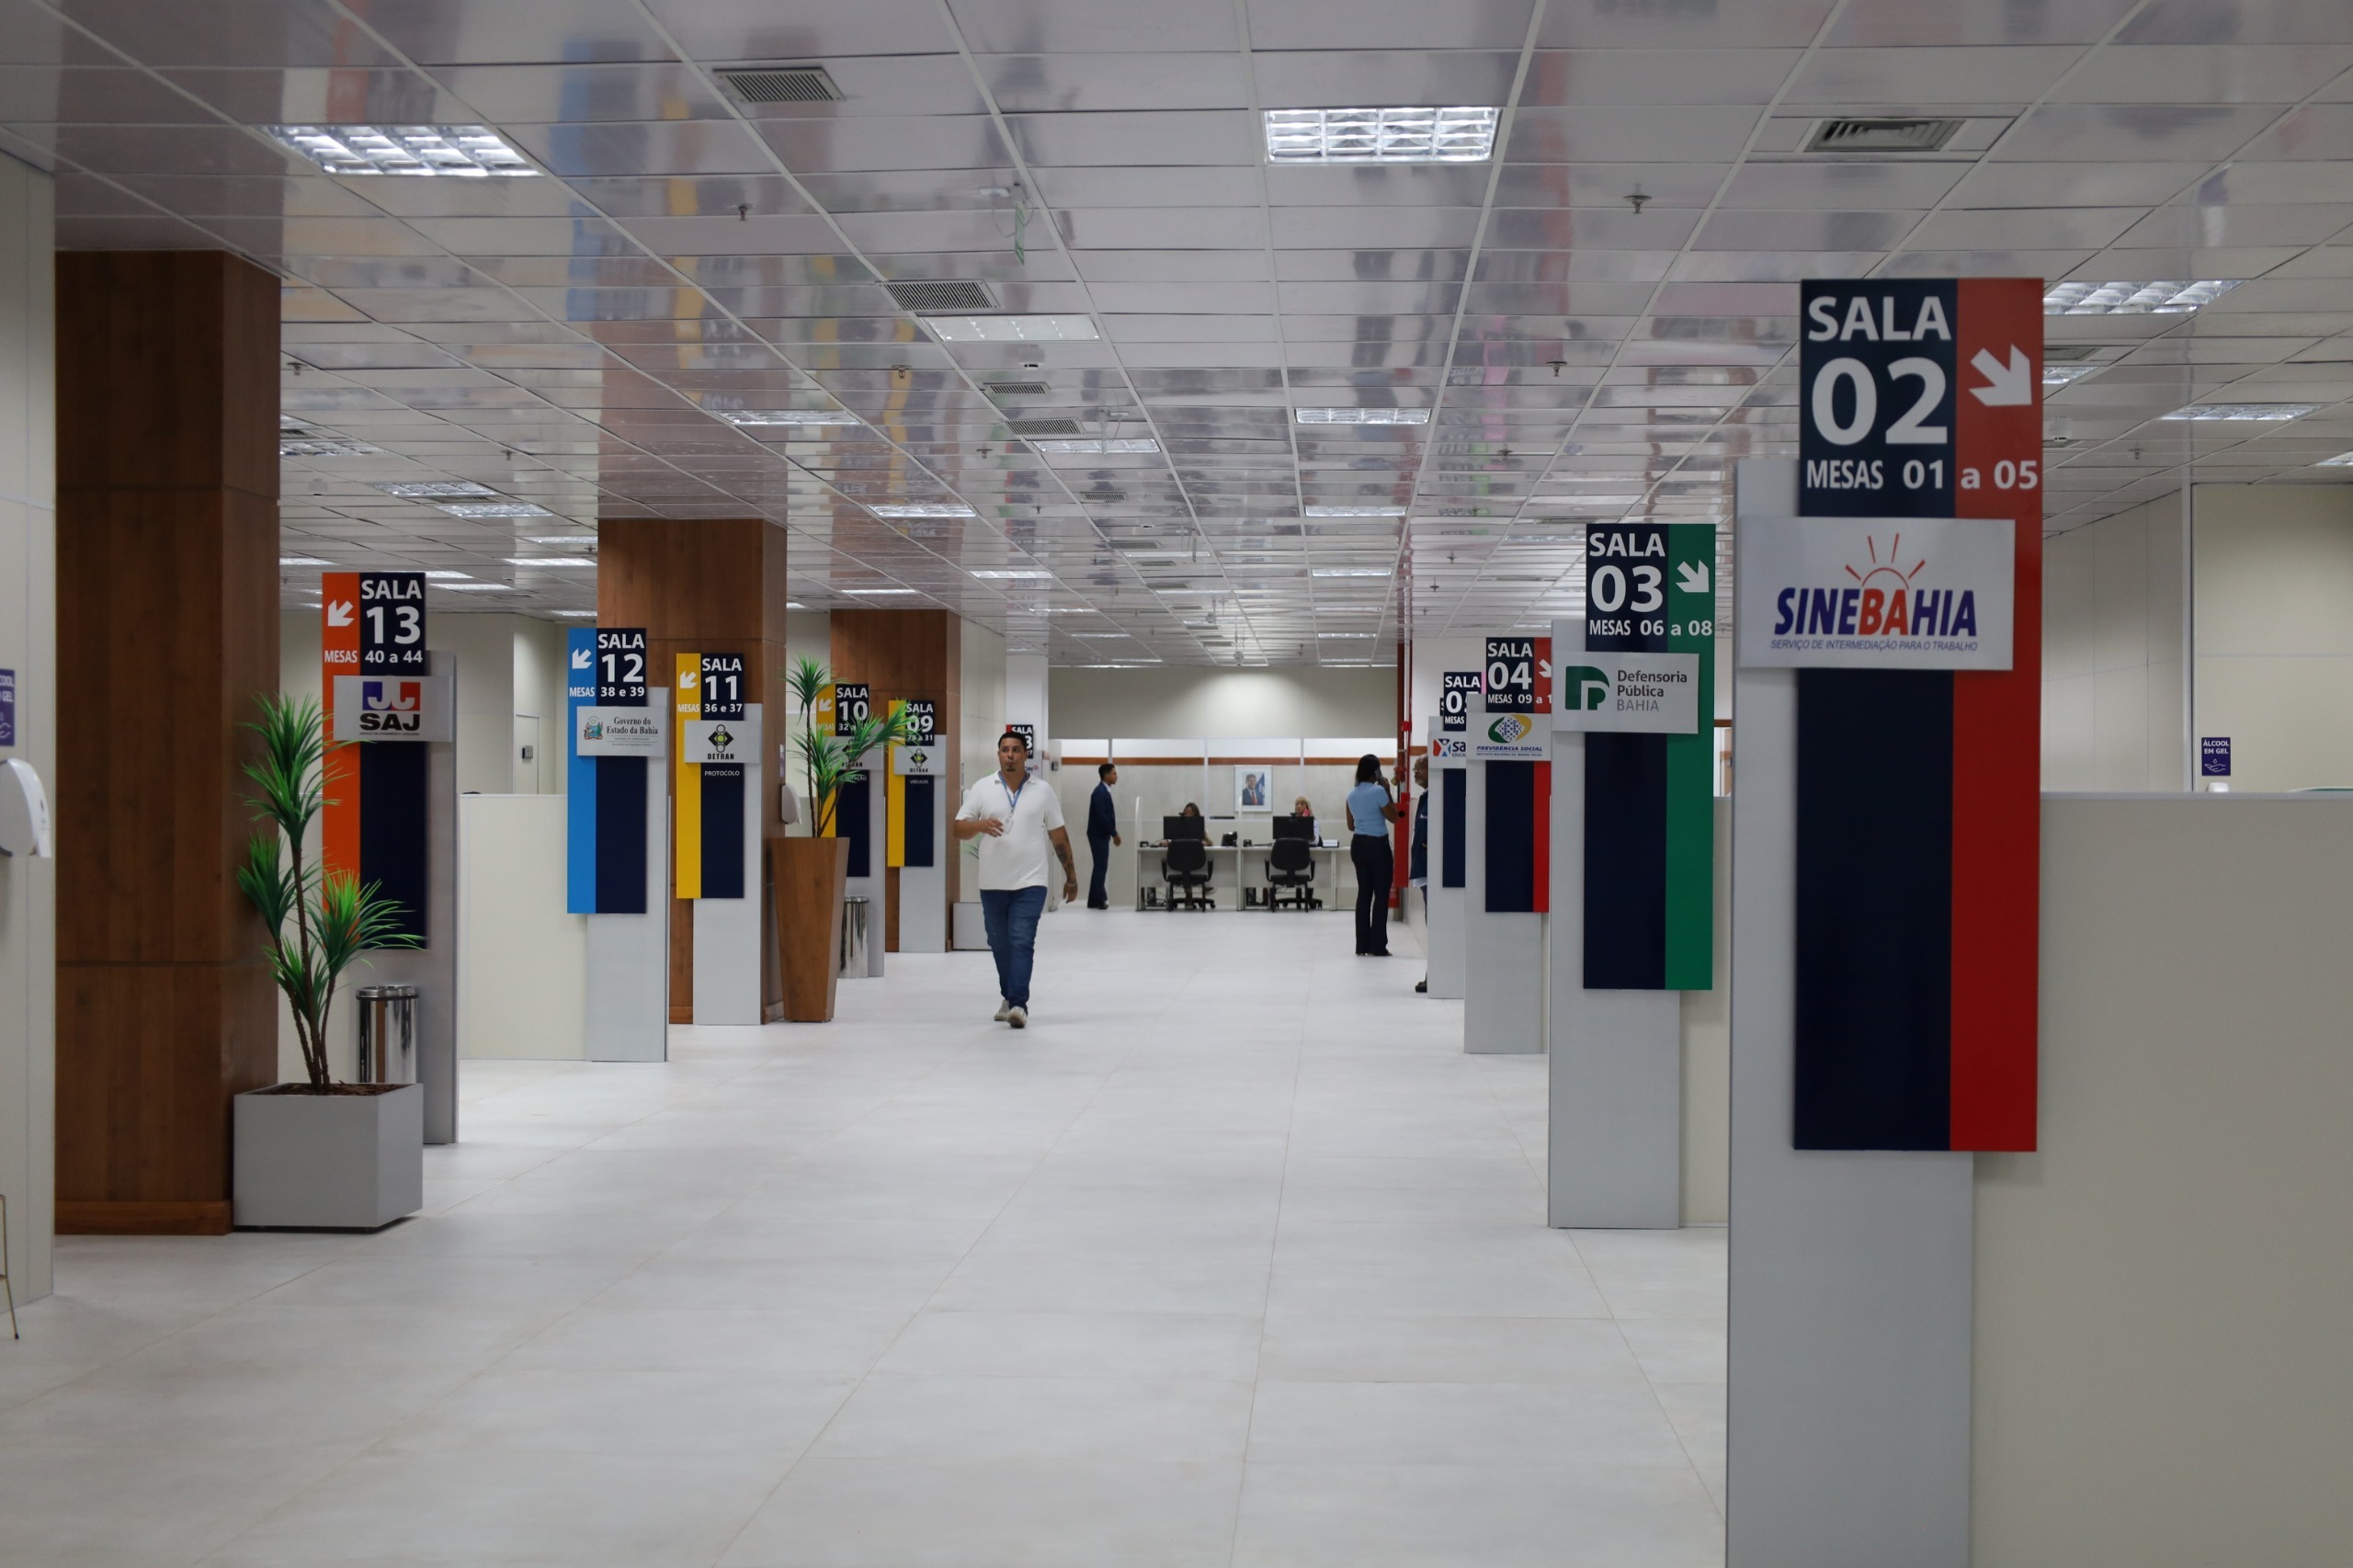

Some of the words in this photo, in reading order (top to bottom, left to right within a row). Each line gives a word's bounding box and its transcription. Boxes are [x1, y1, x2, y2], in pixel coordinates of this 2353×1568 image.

[1808, 296, 1951, 341] SALA
[1812, 357, 1949, 446] 02
[1807, 460, 1883, 489] MESAS
[1903, 460, 1944, 489] 01
[1961, 467, 1980, 489] a
[1994, 460, 2039, 490] 05
[1589, 533, 1666, 557] SALA
[361, 580, 423, 599] SALA
[1591, 565, 1664, 613] 03
[1774, 587, 1977, 637] SINEBAHIA
[367, 606, 421, 644] 13
[1590, 619, 1631, 636] MESAS
[1640, 619, 1665, 636] 06
[1671, 624, 1681, 636] a
[1688, 620, 1712, 636] 08
[598, 634, 645, 649] SALA
[1771, 640, 1810, 652] SERVIÇO
[1812, 640, 1824, 649] DE
[1825, 639, 1897, 652] INTERMEDIAÇÃO
[1899, 641, 1923, 650] PARA
[1924, 641, 1930, 650] O
[1933, 641, 1978, 651] TRABALHO
[324, 651, 358, 663] MESAS
[365, 650, 385, 664] 40
[390, 653, 399, 663] a
[404, 651, 423, 663] 44
[1488, 643, 1533, 658] SALA
[602, 653, 644, 683] 12
[702, 658, 743, 672] SALA
[1445, 676, 1481, 688] SALA
[1488, 662, 1532, 690] 04
[1618, 670, 1688, 683] Defensoria
[570, 687, 596, 698] MESAS
[601, 687, 616, 698] 38
[620, 689, 627, 698] e
[631, 687, 645, 698] 39
[705, 676, 737, 700] 11
[837, 687, 869, 699] SALA
[1618, 685, 1665, 698] Pública
[1488, 694, 1513, 704] MESAS
[1518, 694, 1532, 704] 09
[1548, 694, 1552, 704] 1
[1618, 699, 1659, 711] BAHIA
[678, 704, 700, 712] MESAS
[705, 704, 718, 712] 36
[730, 704, 743, 712] 37
[839, 701, 869, 722] 10
[907, 704, 934, 713] SALA
[360, 713, 420, 732] SAJ
[614, 717, 642, 725] Governo
[643, 717, 652, 725] do
[907, 715, 934, 733] 09
[1445, 716, 1465, 724] MESAS
[607, 726, 629, 734] Estado
[630, 726, 638, 734] da
[640, 727, 658, 735] Bahia
[1453, 742, 1467, 753] sa
[2203, 739, 2230, 747] ÁLCOOL
